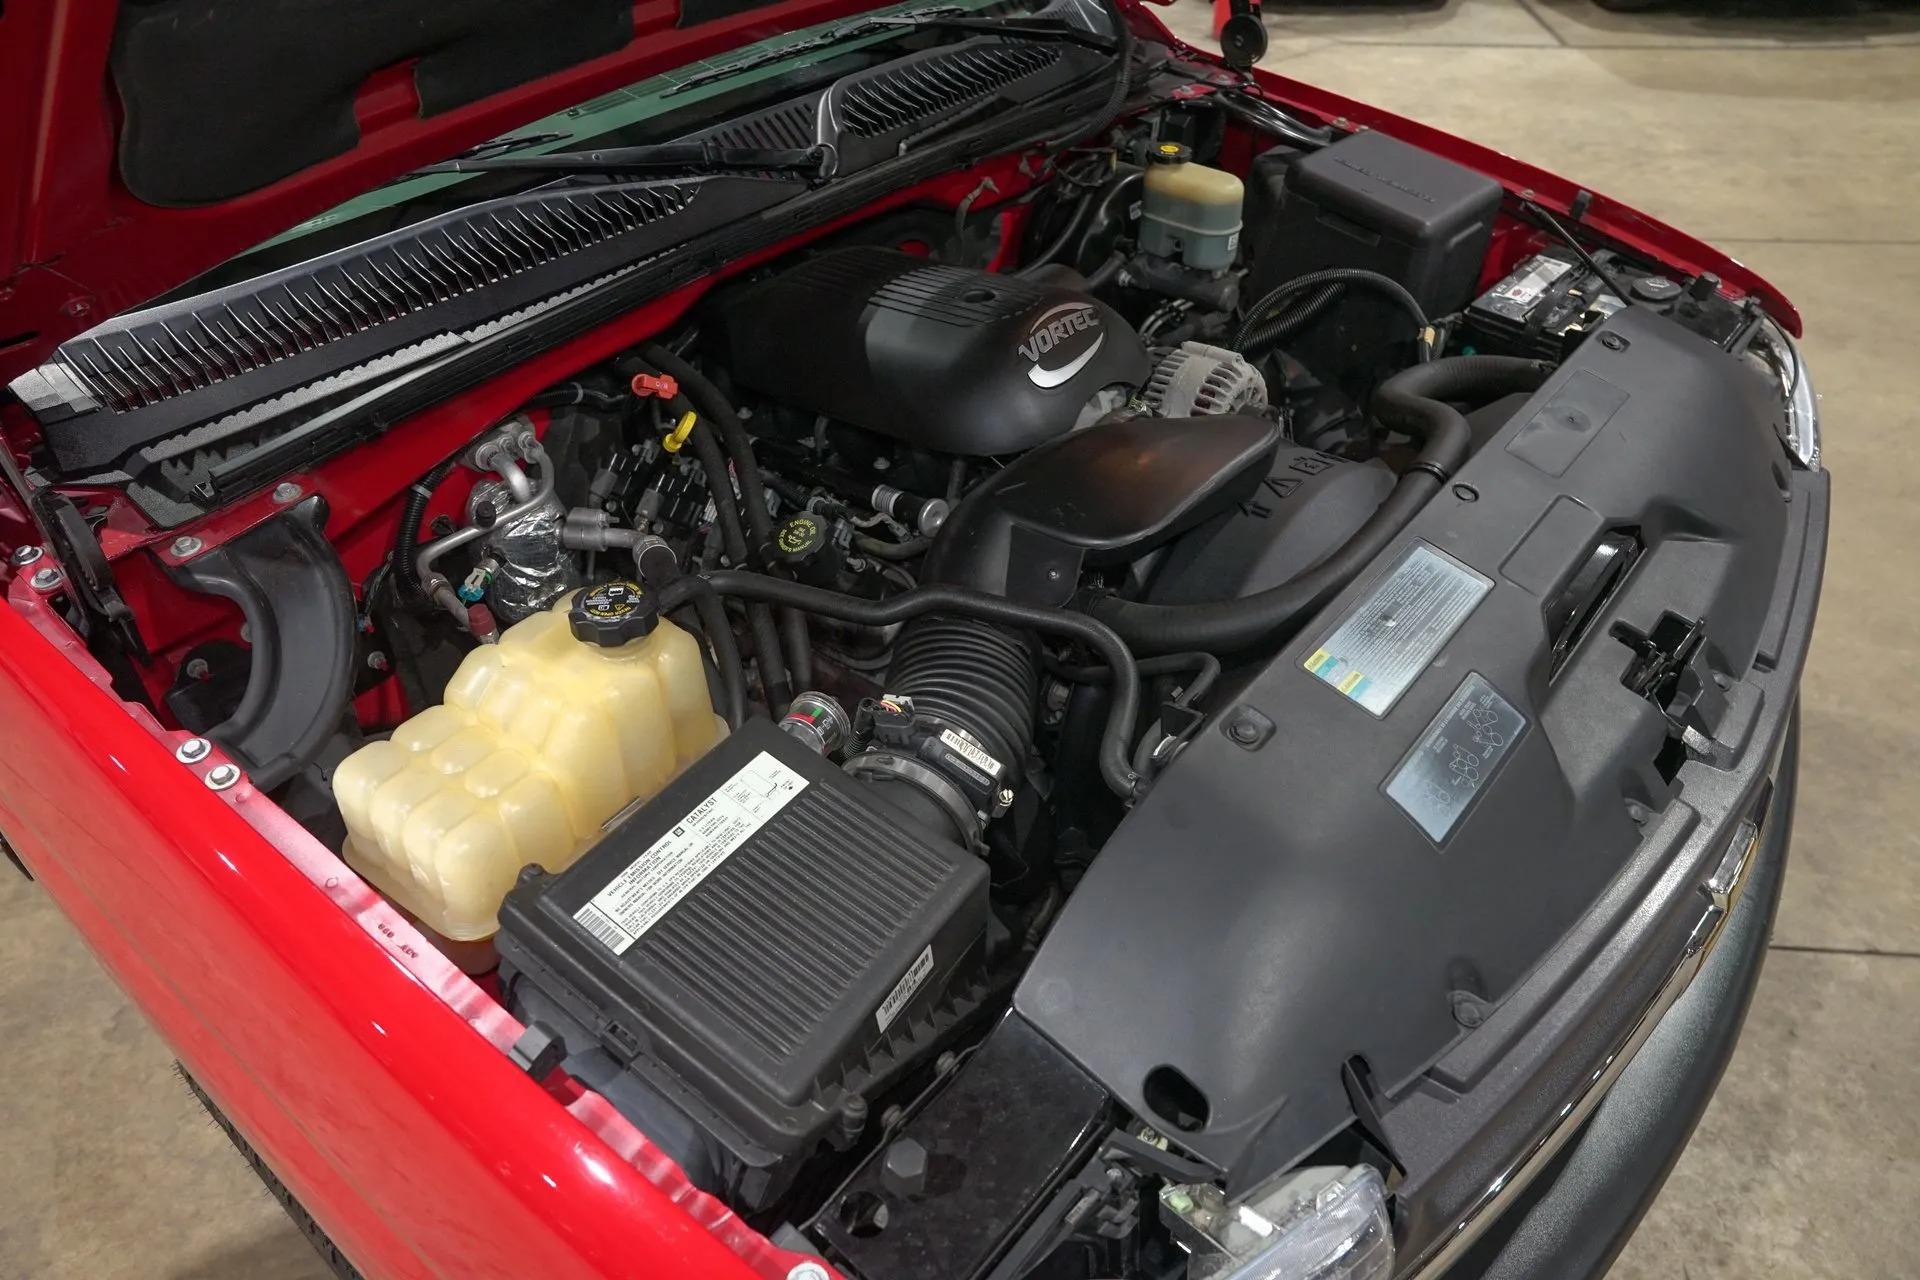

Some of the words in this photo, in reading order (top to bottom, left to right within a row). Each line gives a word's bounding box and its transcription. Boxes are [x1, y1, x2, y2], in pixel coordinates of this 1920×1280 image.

[1017, 308, 1100, 363] VORTEC
[790, 519, 813, 528] ENGINE
[685, 796, 717, 824] CATALYST
[606, 878, 627, 896] VEHICLE
[626, 858, 650, 879] EMISSION
[649, 839, 671, 859] CONTROL
[628, 856, 661, 884] INFORMATION
